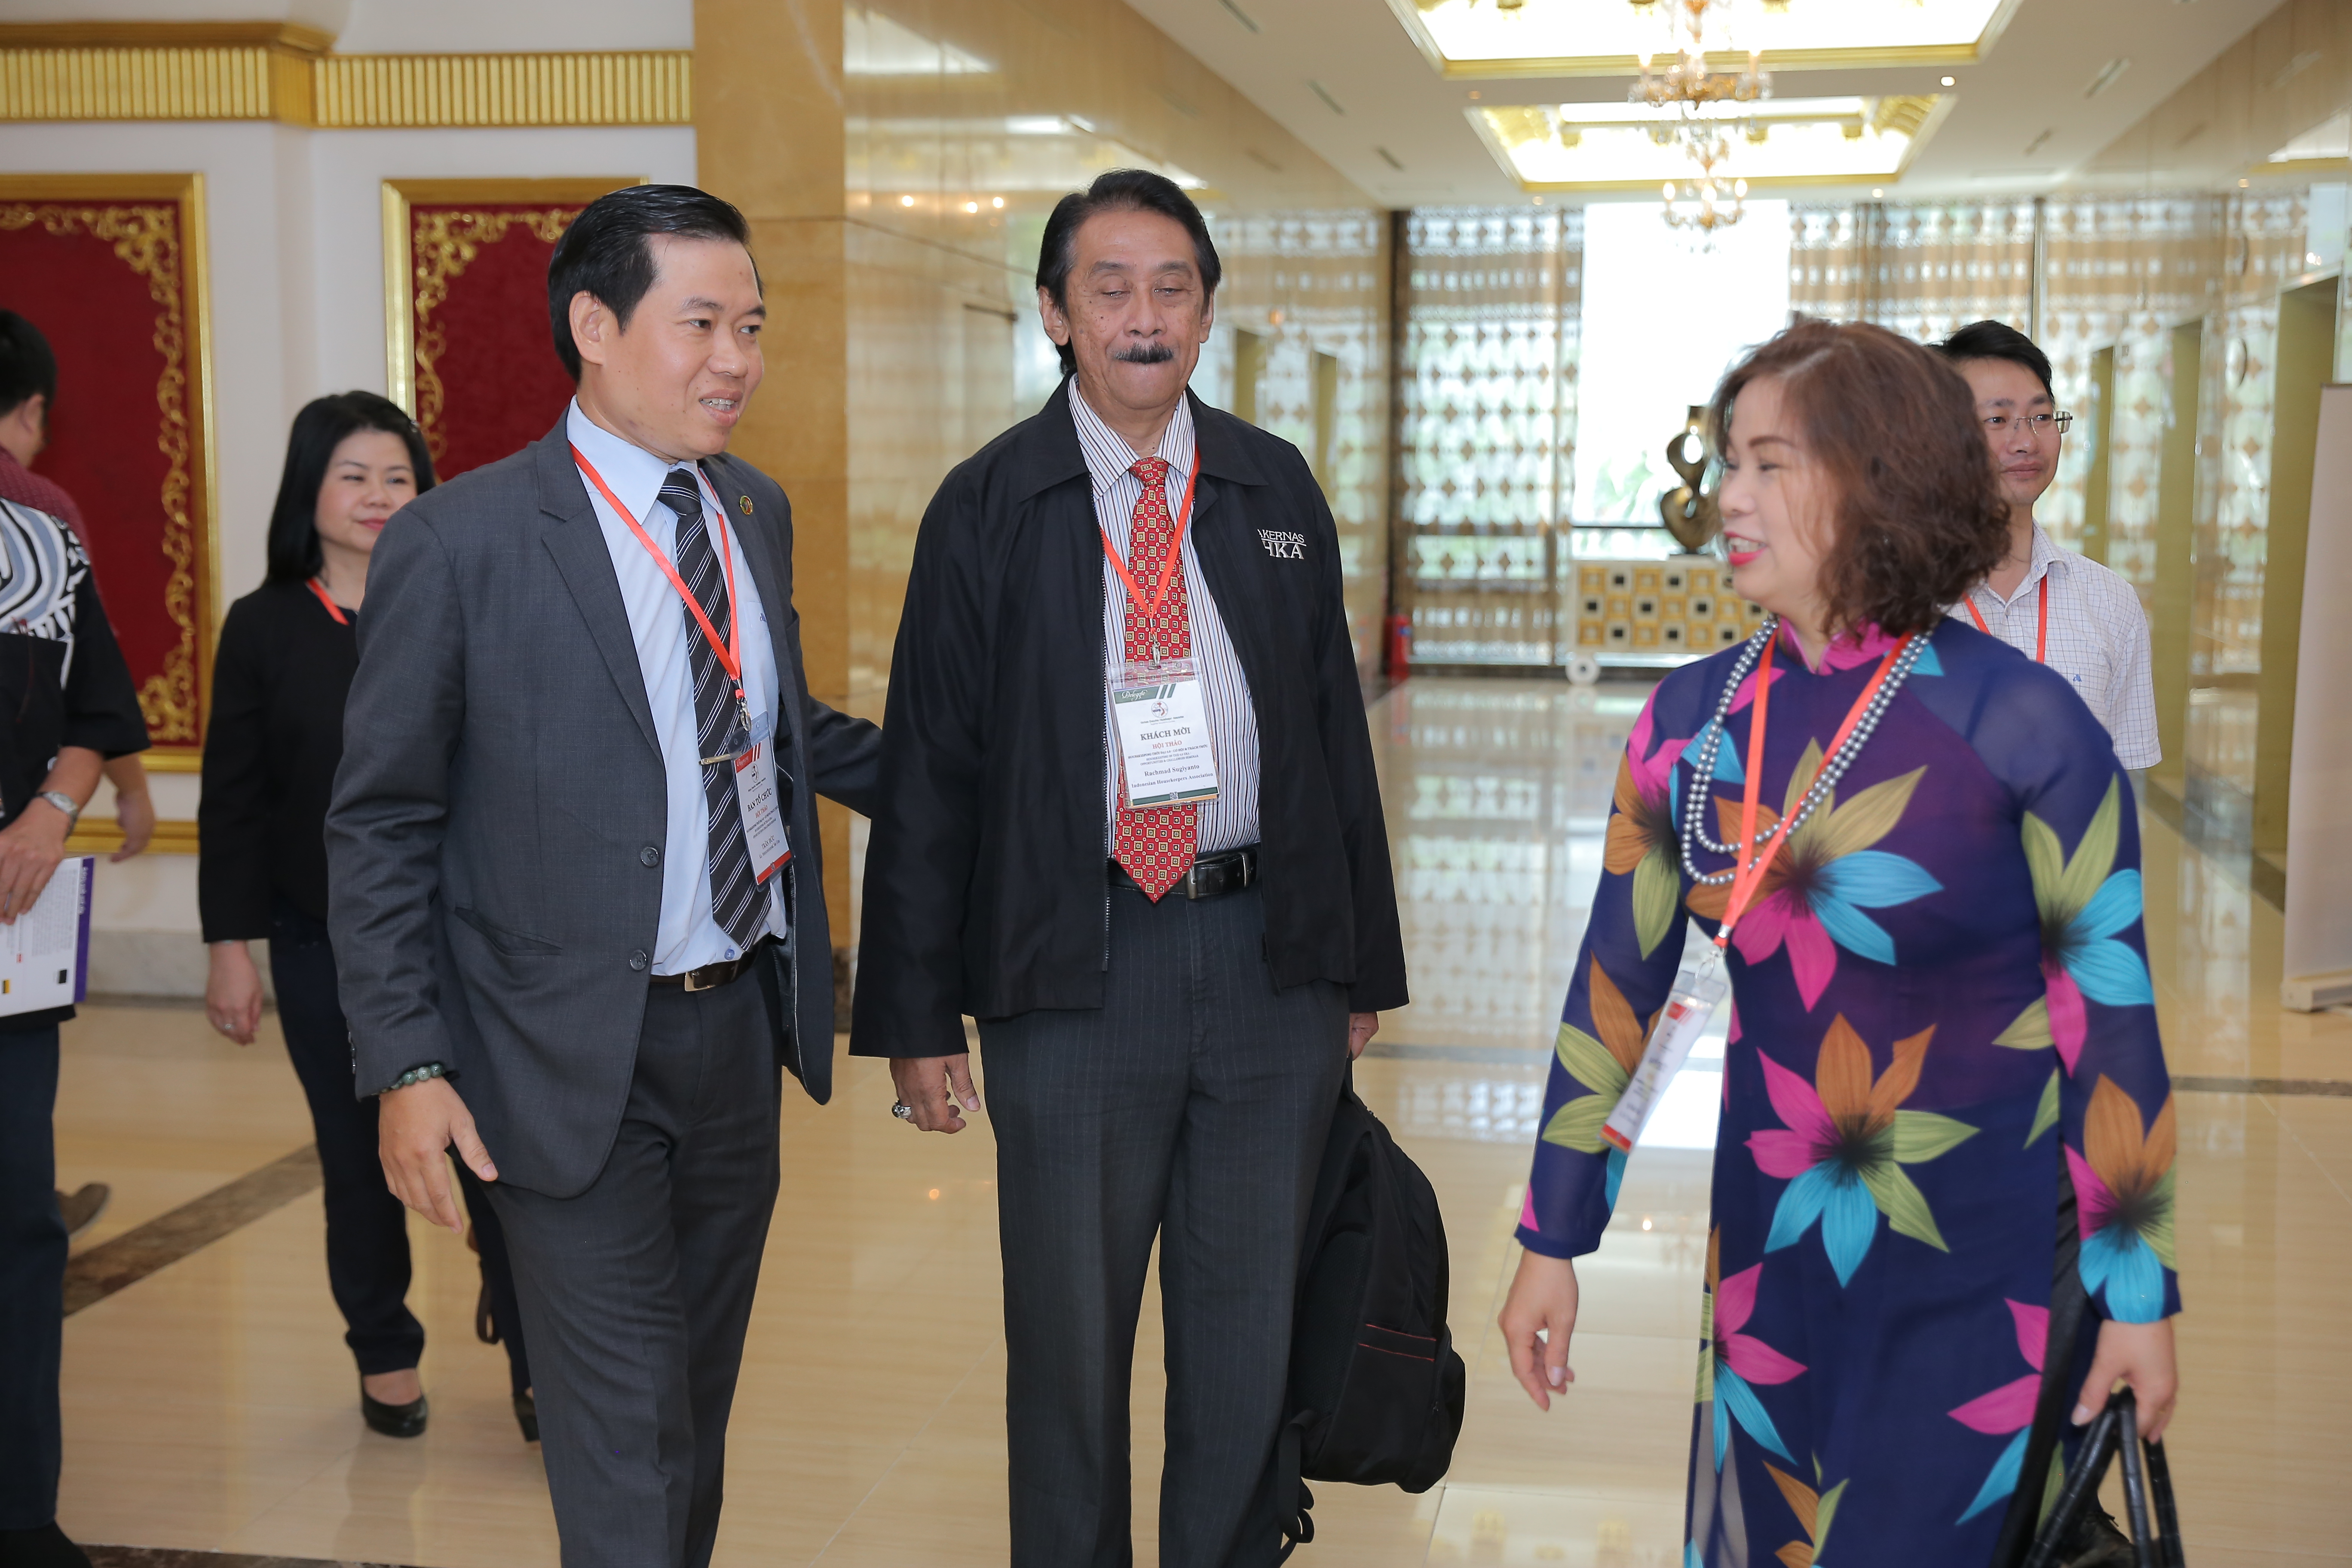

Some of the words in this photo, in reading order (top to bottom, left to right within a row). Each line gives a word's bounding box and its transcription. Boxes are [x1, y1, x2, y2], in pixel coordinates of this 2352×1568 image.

[1140, 730, 1171, 741] KHÁCH
[1173, 727, 1191, 736] MỜI
[1165, 740, 1182, 748] THẢO
[1144, 768, 1171, 776] Rachmad
[1172, 764, 1200, 772] Sugiyanto
[1157, 777, 1188, 785] Housekeepers
[747, 800, 756, 812] BAN
